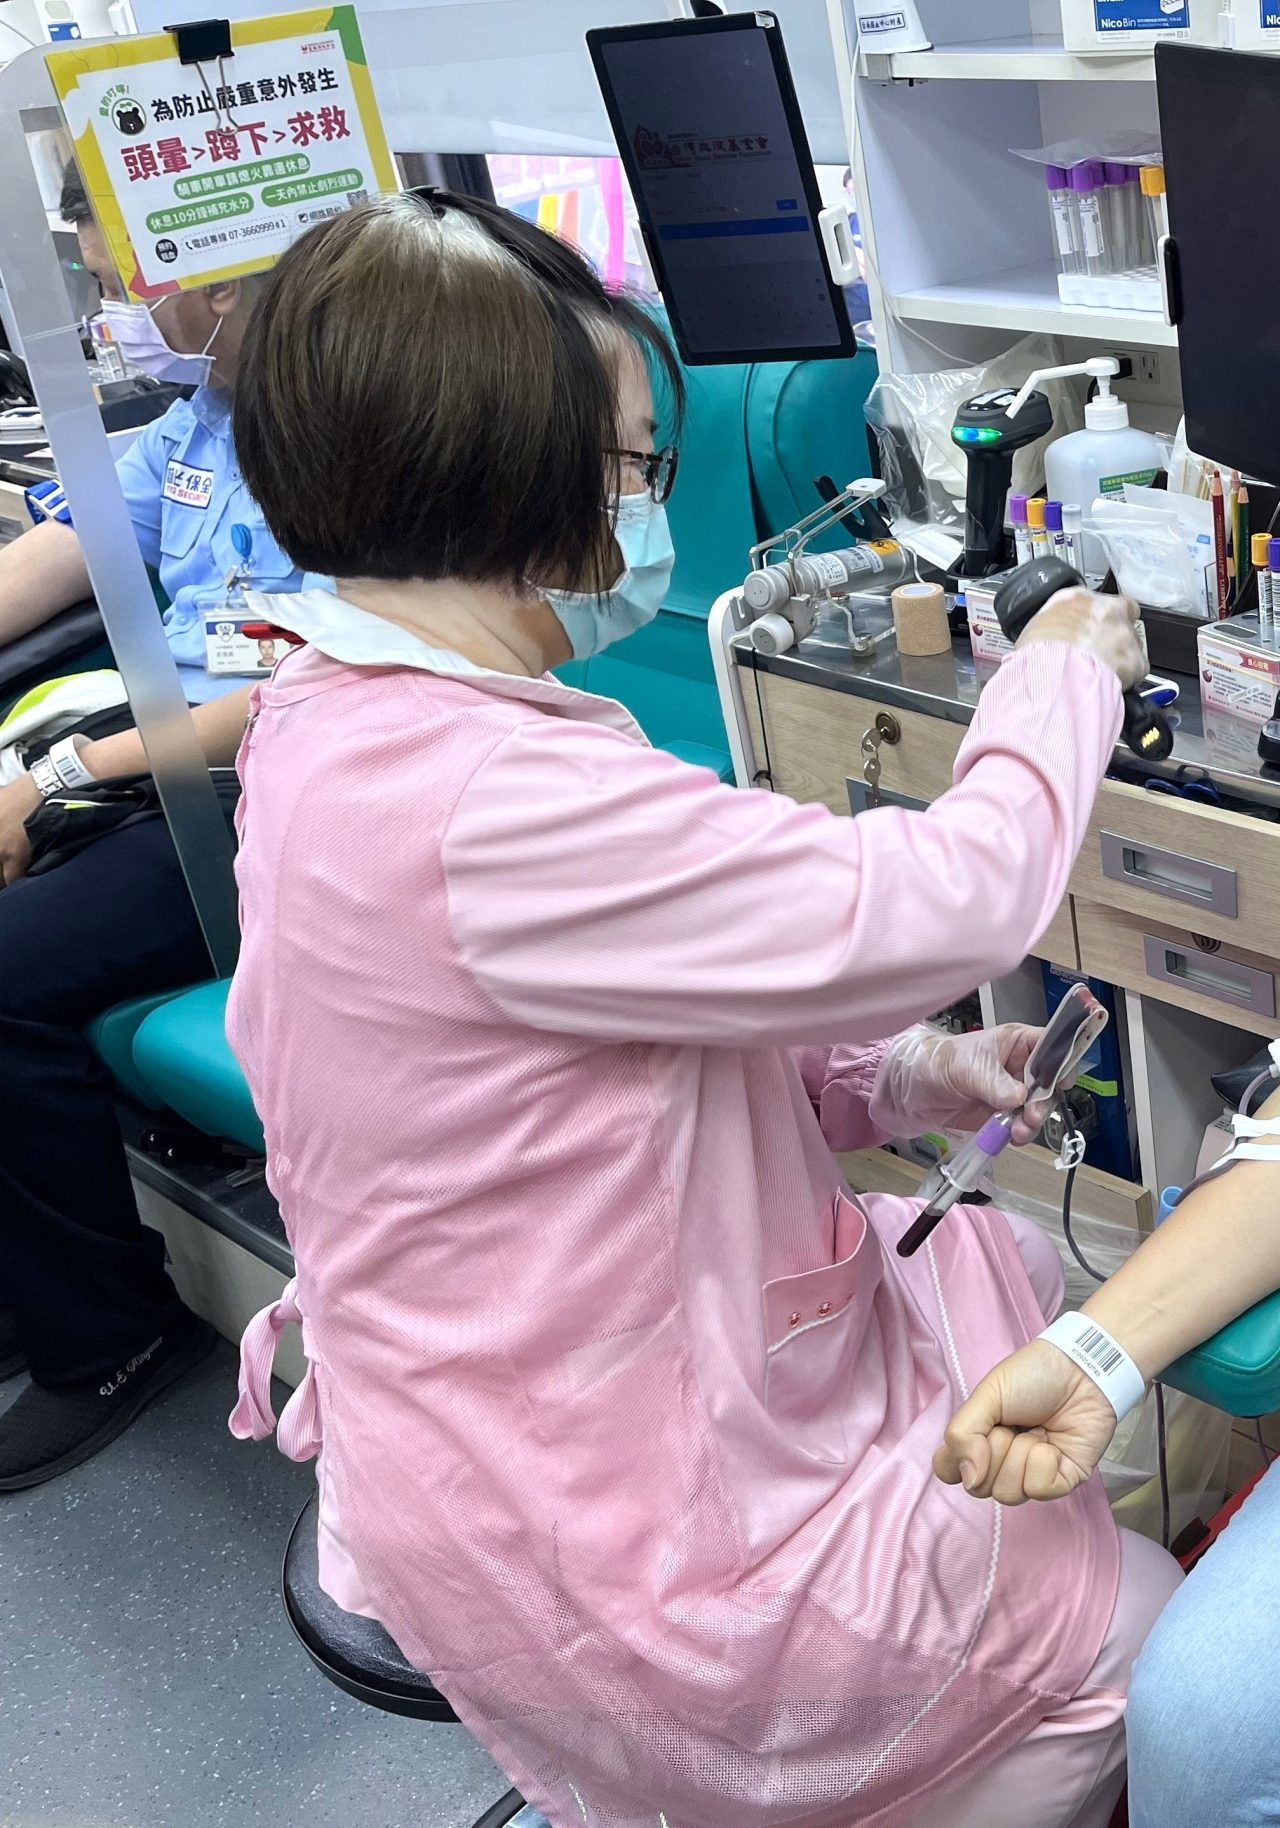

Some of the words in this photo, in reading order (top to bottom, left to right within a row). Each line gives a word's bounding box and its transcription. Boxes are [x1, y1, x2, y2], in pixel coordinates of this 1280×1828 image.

[1101, 18, 1137, 29] NicoBin
[151, 67, 339, 122] 為防止嚴重意外發生
